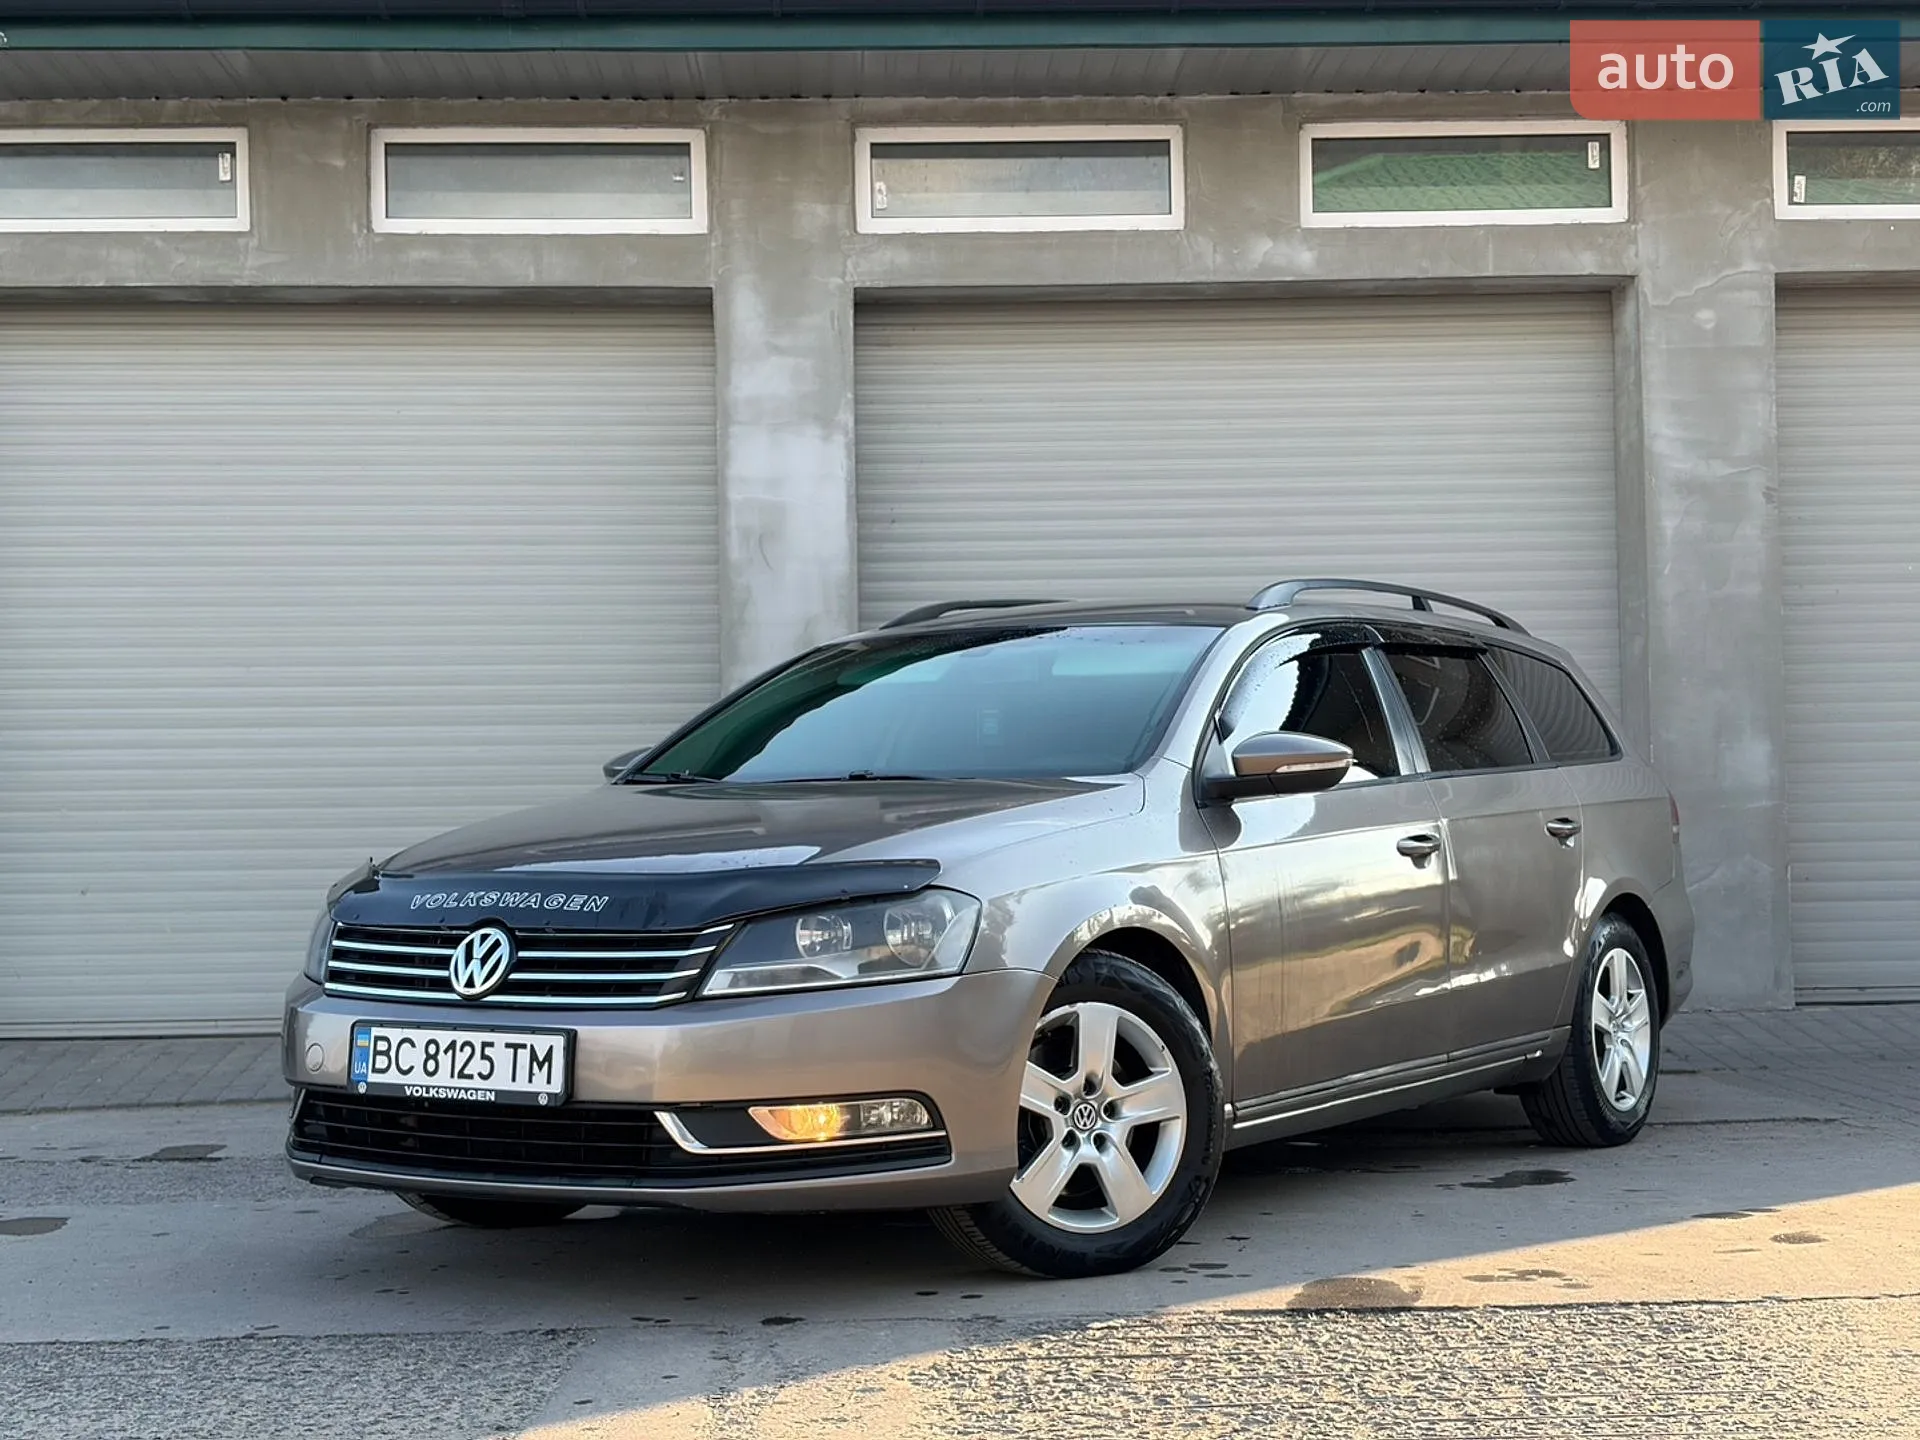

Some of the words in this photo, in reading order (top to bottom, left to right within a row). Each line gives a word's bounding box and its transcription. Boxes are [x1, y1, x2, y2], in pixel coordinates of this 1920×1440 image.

[409, 891, 609, 912] VOLKSWAGEN
[354, 1061, 367, 1075] UA
[371, 1035, 417, 1076] BC
[422, 1038, 496, 1081] 8125
[504, 1042, 554, 1085] TM
[404, 1085, 495, 1101] VOLKSWAGEN
